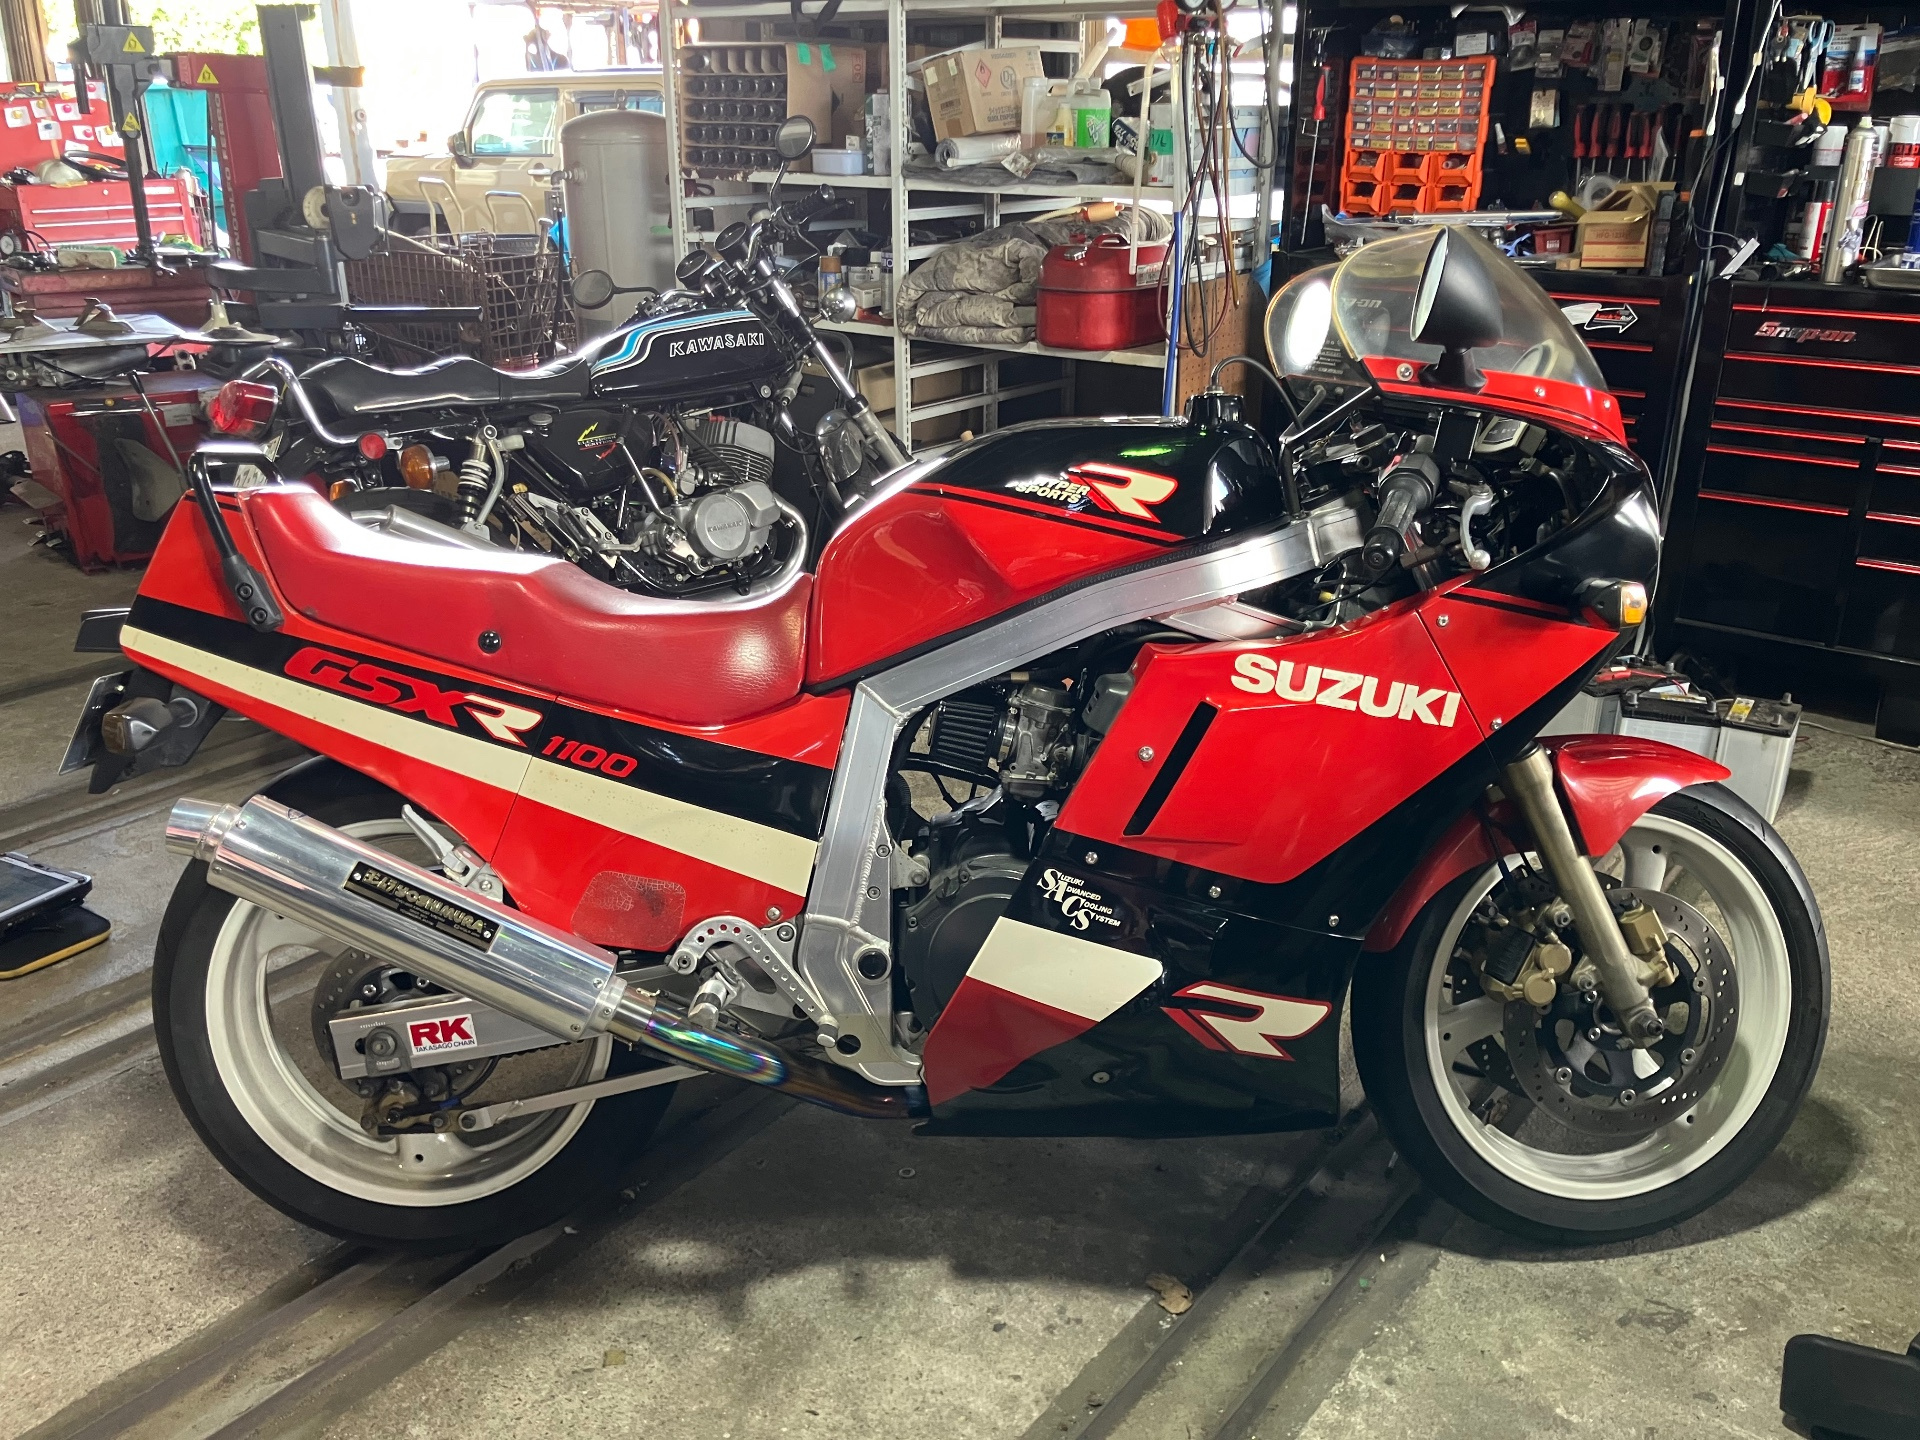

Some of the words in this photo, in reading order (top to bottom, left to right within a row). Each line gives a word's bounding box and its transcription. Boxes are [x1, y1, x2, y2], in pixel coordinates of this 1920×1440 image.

[214, 93, 229, 160] FERRO
[224, 167, 242, 260] ONDOLFO
[669, 332, 765, 358] KAWASAKI
[1754, 321, 1857, 343] Snap-on
[1015, 482, 1082, 504] SPORTS
[1067, 463, 1179, 524] R
[1230, 653, 1461, 728] SUZUKI
[540, 734, 638, 778] 1100
[1037, 868, 1085, 890] SUZUKI
[1043, 879, 1102, 903] ADVANCED
[395, 884, 484, 934] YOSHIMURA
[1061, 895, 1113, 917] COOLING
[1070, 909, 1121, 931] SYSTEM
[410, 1016, 473, 1047] RK
[1160, 980, 1333, 1062] R
[416, 1042, 453, 1053] TAKASAGO
[453, 1039, 476, 1048] CHAIN
